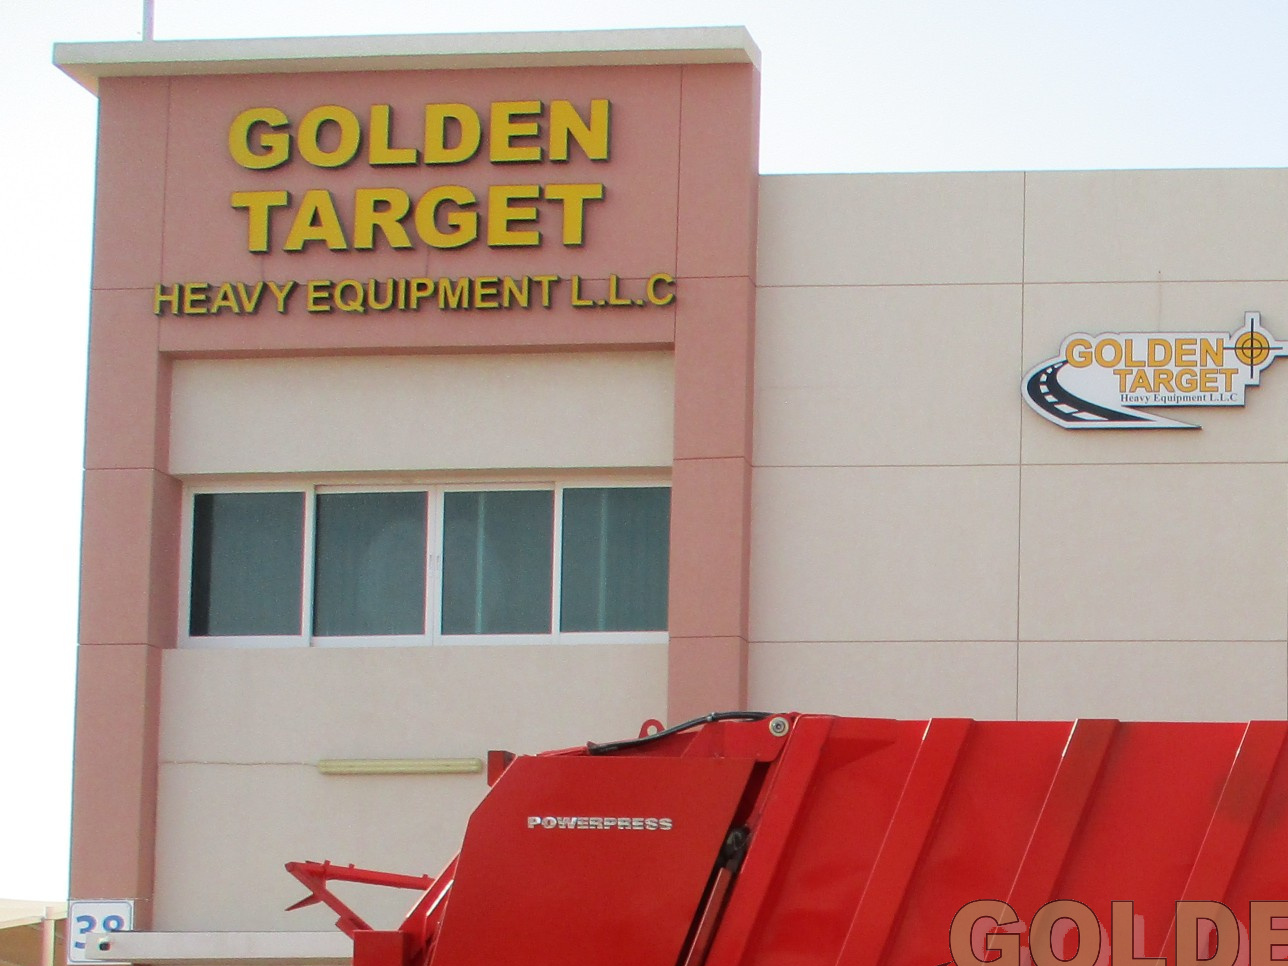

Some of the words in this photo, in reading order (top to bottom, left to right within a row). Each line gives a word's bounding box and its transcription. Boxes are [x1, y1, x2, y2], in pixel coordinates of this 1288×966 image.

[228, 98, 613, 171] GOLDEN
[230, 182, 605, 254] TARGET
[153, 279, 297, 316] HEAVY
[306, 273, 560, 315] EQUIPMENT
[571, 272, 677, 309] L.L.C
[1064, 337, 1225, 369] GOLDEN
[1112, 367, 1240, 394] TARGET
[1119, 393, 1151, 404] Heavy
[1153, 393, 1207, 404] Equipment
[1208, 392, 1239, 403] L.L.C
[526, 815, 674, 831] POWERPRESS
